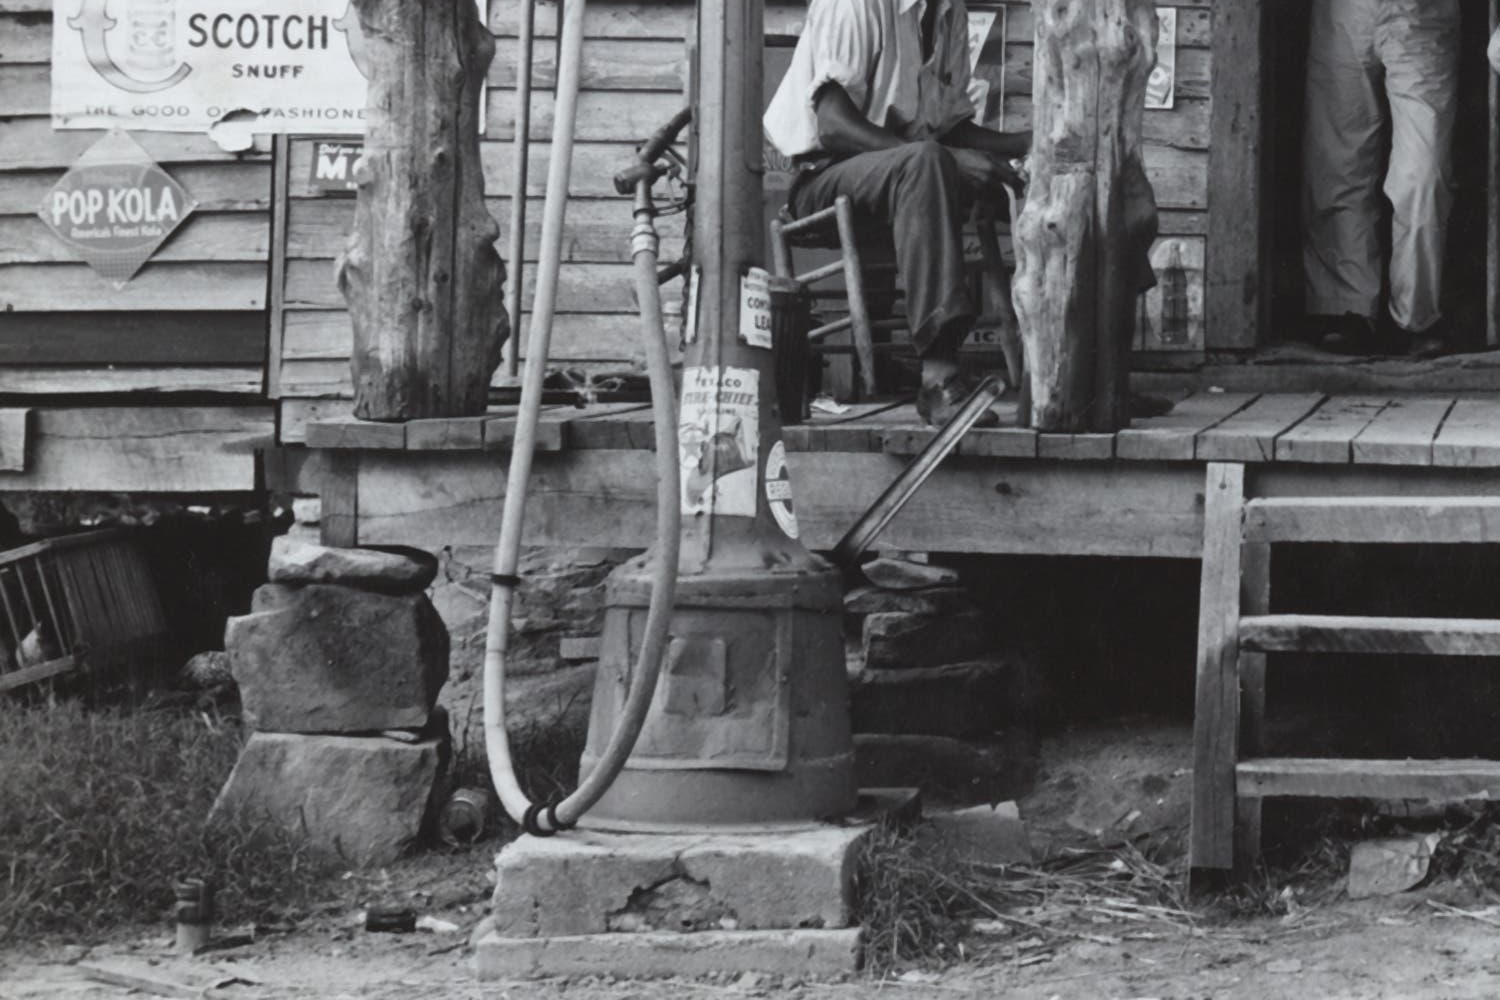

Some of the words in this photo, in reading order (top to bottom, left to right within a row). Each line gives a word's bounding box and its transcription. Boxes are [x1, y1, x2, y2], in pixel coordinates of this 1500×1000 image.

[188, 13, 329, 50] SCOTCH
[231, 64, 305, 79] SNUFF
[131, 104, 190, 118] GOOD
[267, 106, 368, 121] ASHIONE
[52, 188, 104, 226] POP
[107, 186, 178, 223] KOLA
